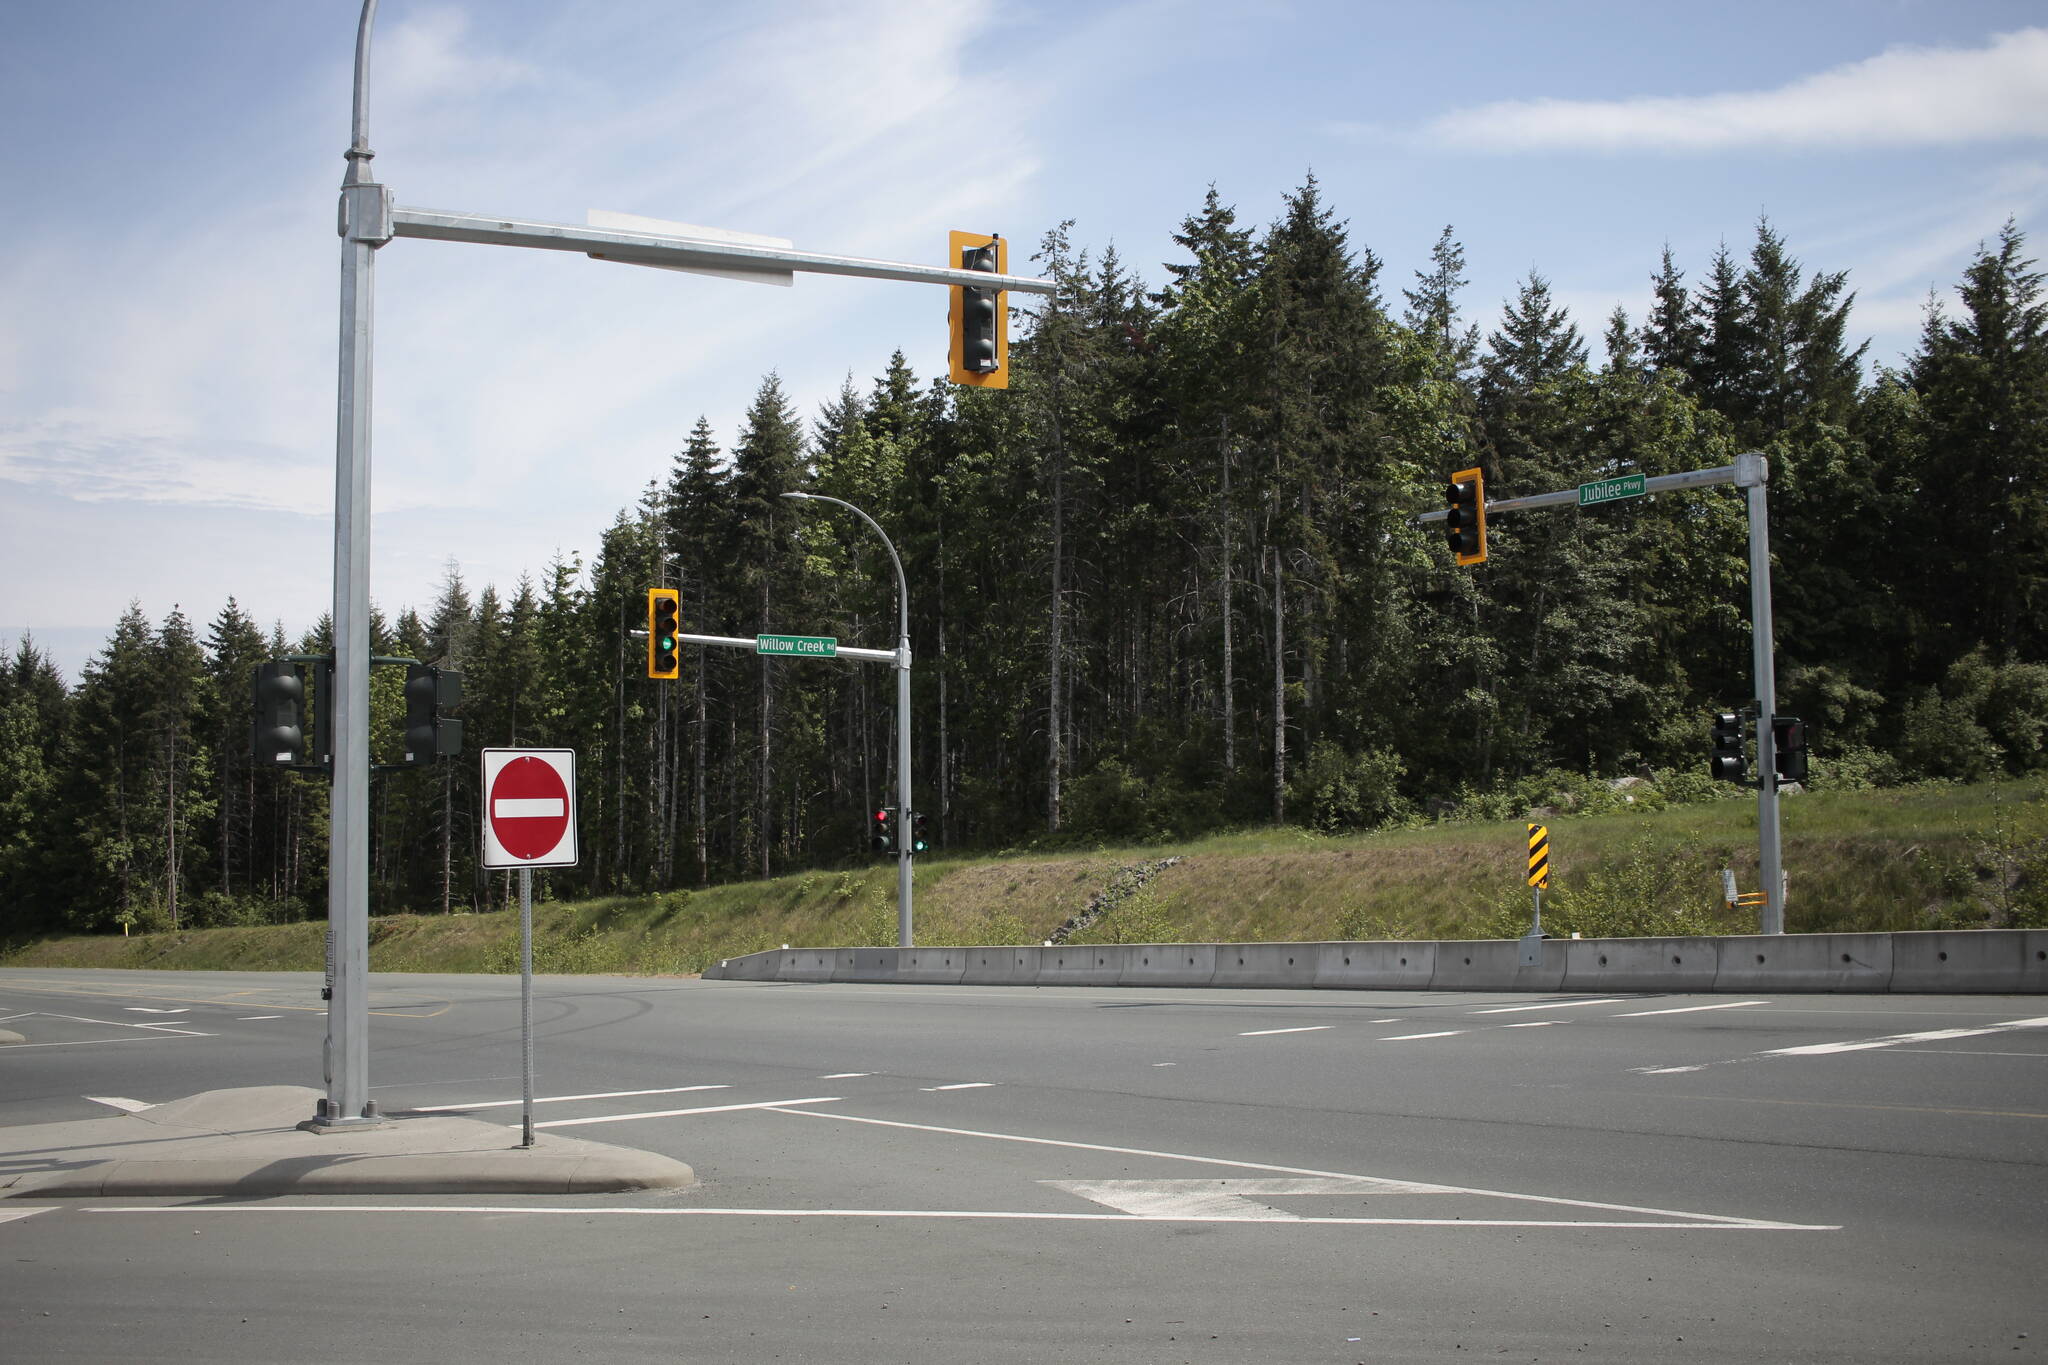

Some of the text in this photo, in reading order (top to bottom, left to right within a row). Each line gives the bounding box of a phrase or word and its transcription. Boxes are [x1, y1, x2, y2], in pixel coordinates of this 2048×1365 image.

[1584, 481, 1641, 502] Jubilee Pkwy
[760, 638, 794, 651] Willow
[797, 640, 825, 652] Creek
